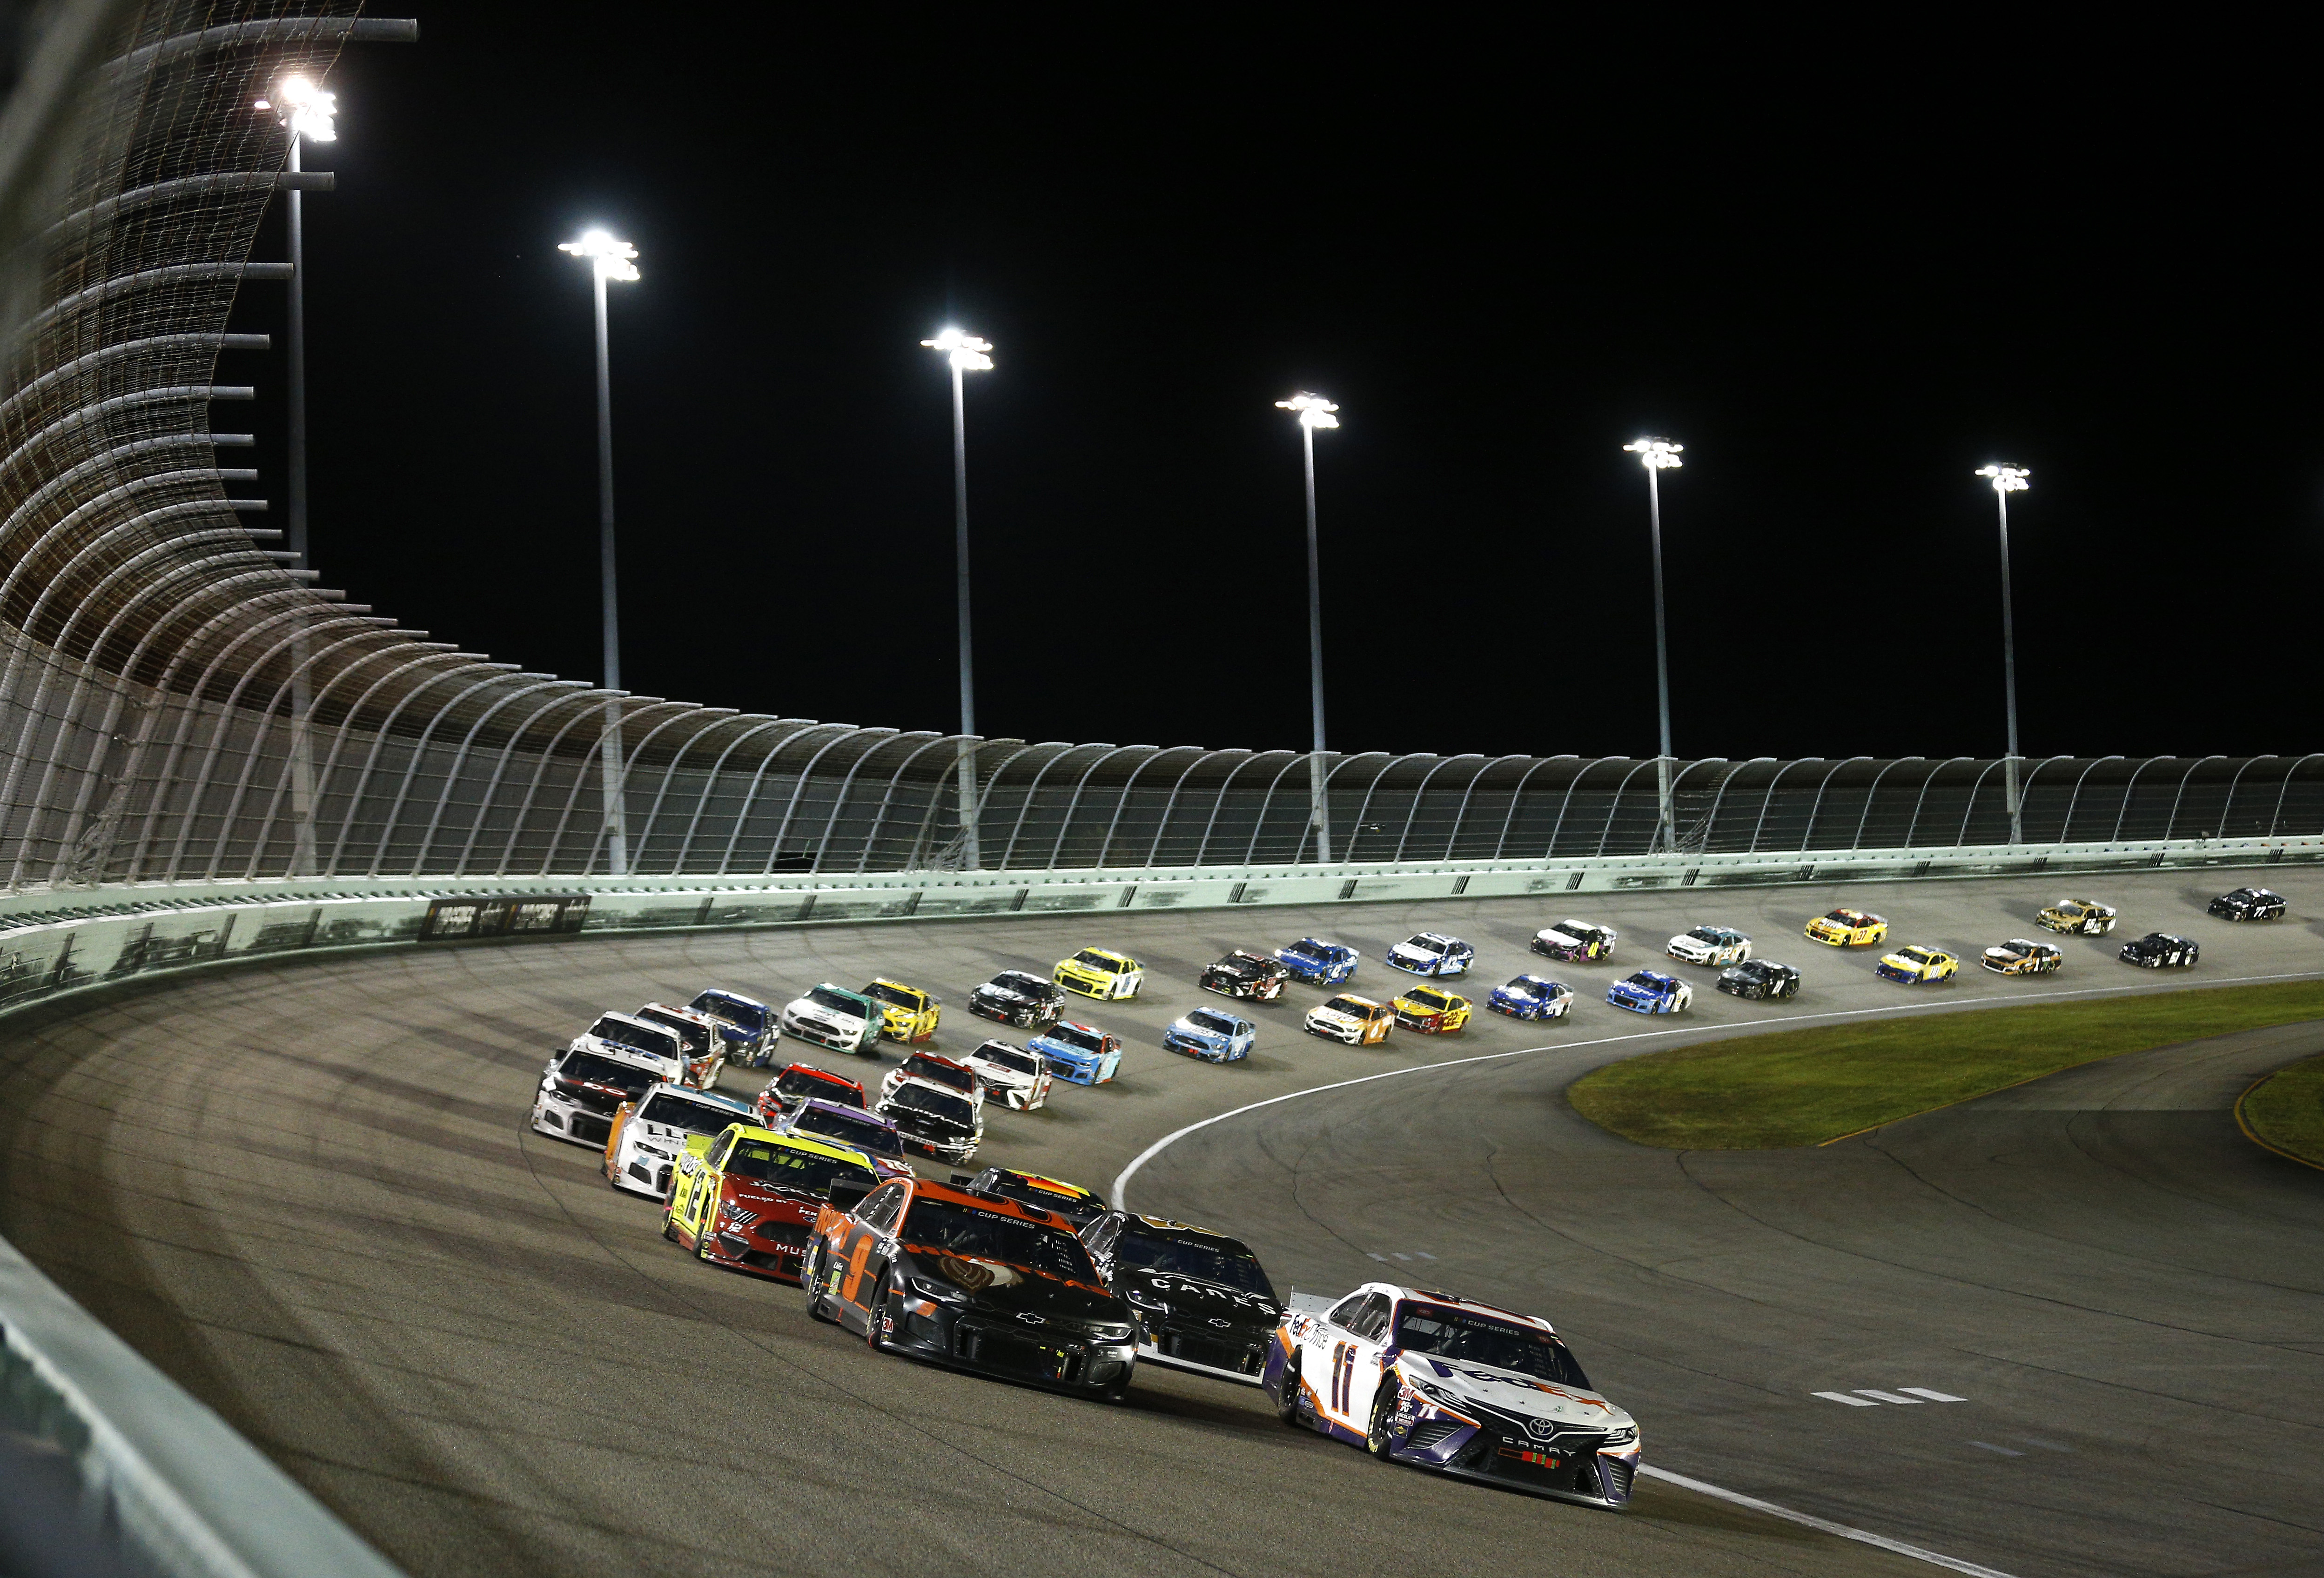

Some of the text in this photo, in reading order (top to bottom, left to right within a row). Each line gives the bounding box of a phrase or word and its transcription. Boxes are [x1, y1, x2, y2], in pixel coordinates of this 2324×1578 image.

[2254, 906, 2266, 917] 77
[2084, 918, 2096, 930] 66
[1857, 930, 1867, 941] 37
[1720, 947, 1733, 960] 32
[1445, 956, 1458, 971] 13
[1331, 963, 1343, 979] 42
[1929, 966, 1940, 977] 00
[1370, 1023, 1380, 1039] 6
[808, 1153, 838, 1164] SERIES
[749, 1180, 809, 1196] JACK
[739, 1193, 774, 1202] FUELED
[1054, 1193, 1077, 1203] SERIES
[978, 1211, 1035, 1229] CUP SERIES
[727, 1222, 744, 1232] 12
[776, 1244, 806, 1257] MUS
[1194, 1243, 1220, 1252] SERIES
[842, 1234, 874, 1302] 9
[1151, 1278, 1276, 1315] CARES
[882, 1320, 893, 1331] 3M
[1290, 1314, 1328, 1350] FedEx Office
[1488, 1325, 1519, 1336] SERIES
[1332, 1340, 1358, 1417] 11
[1427, 1357, 1614, 1416] FedEx
[1398, 1387, 1415, 1400] 3M
[1502, 1436, 1576, 1457] CAMRY
